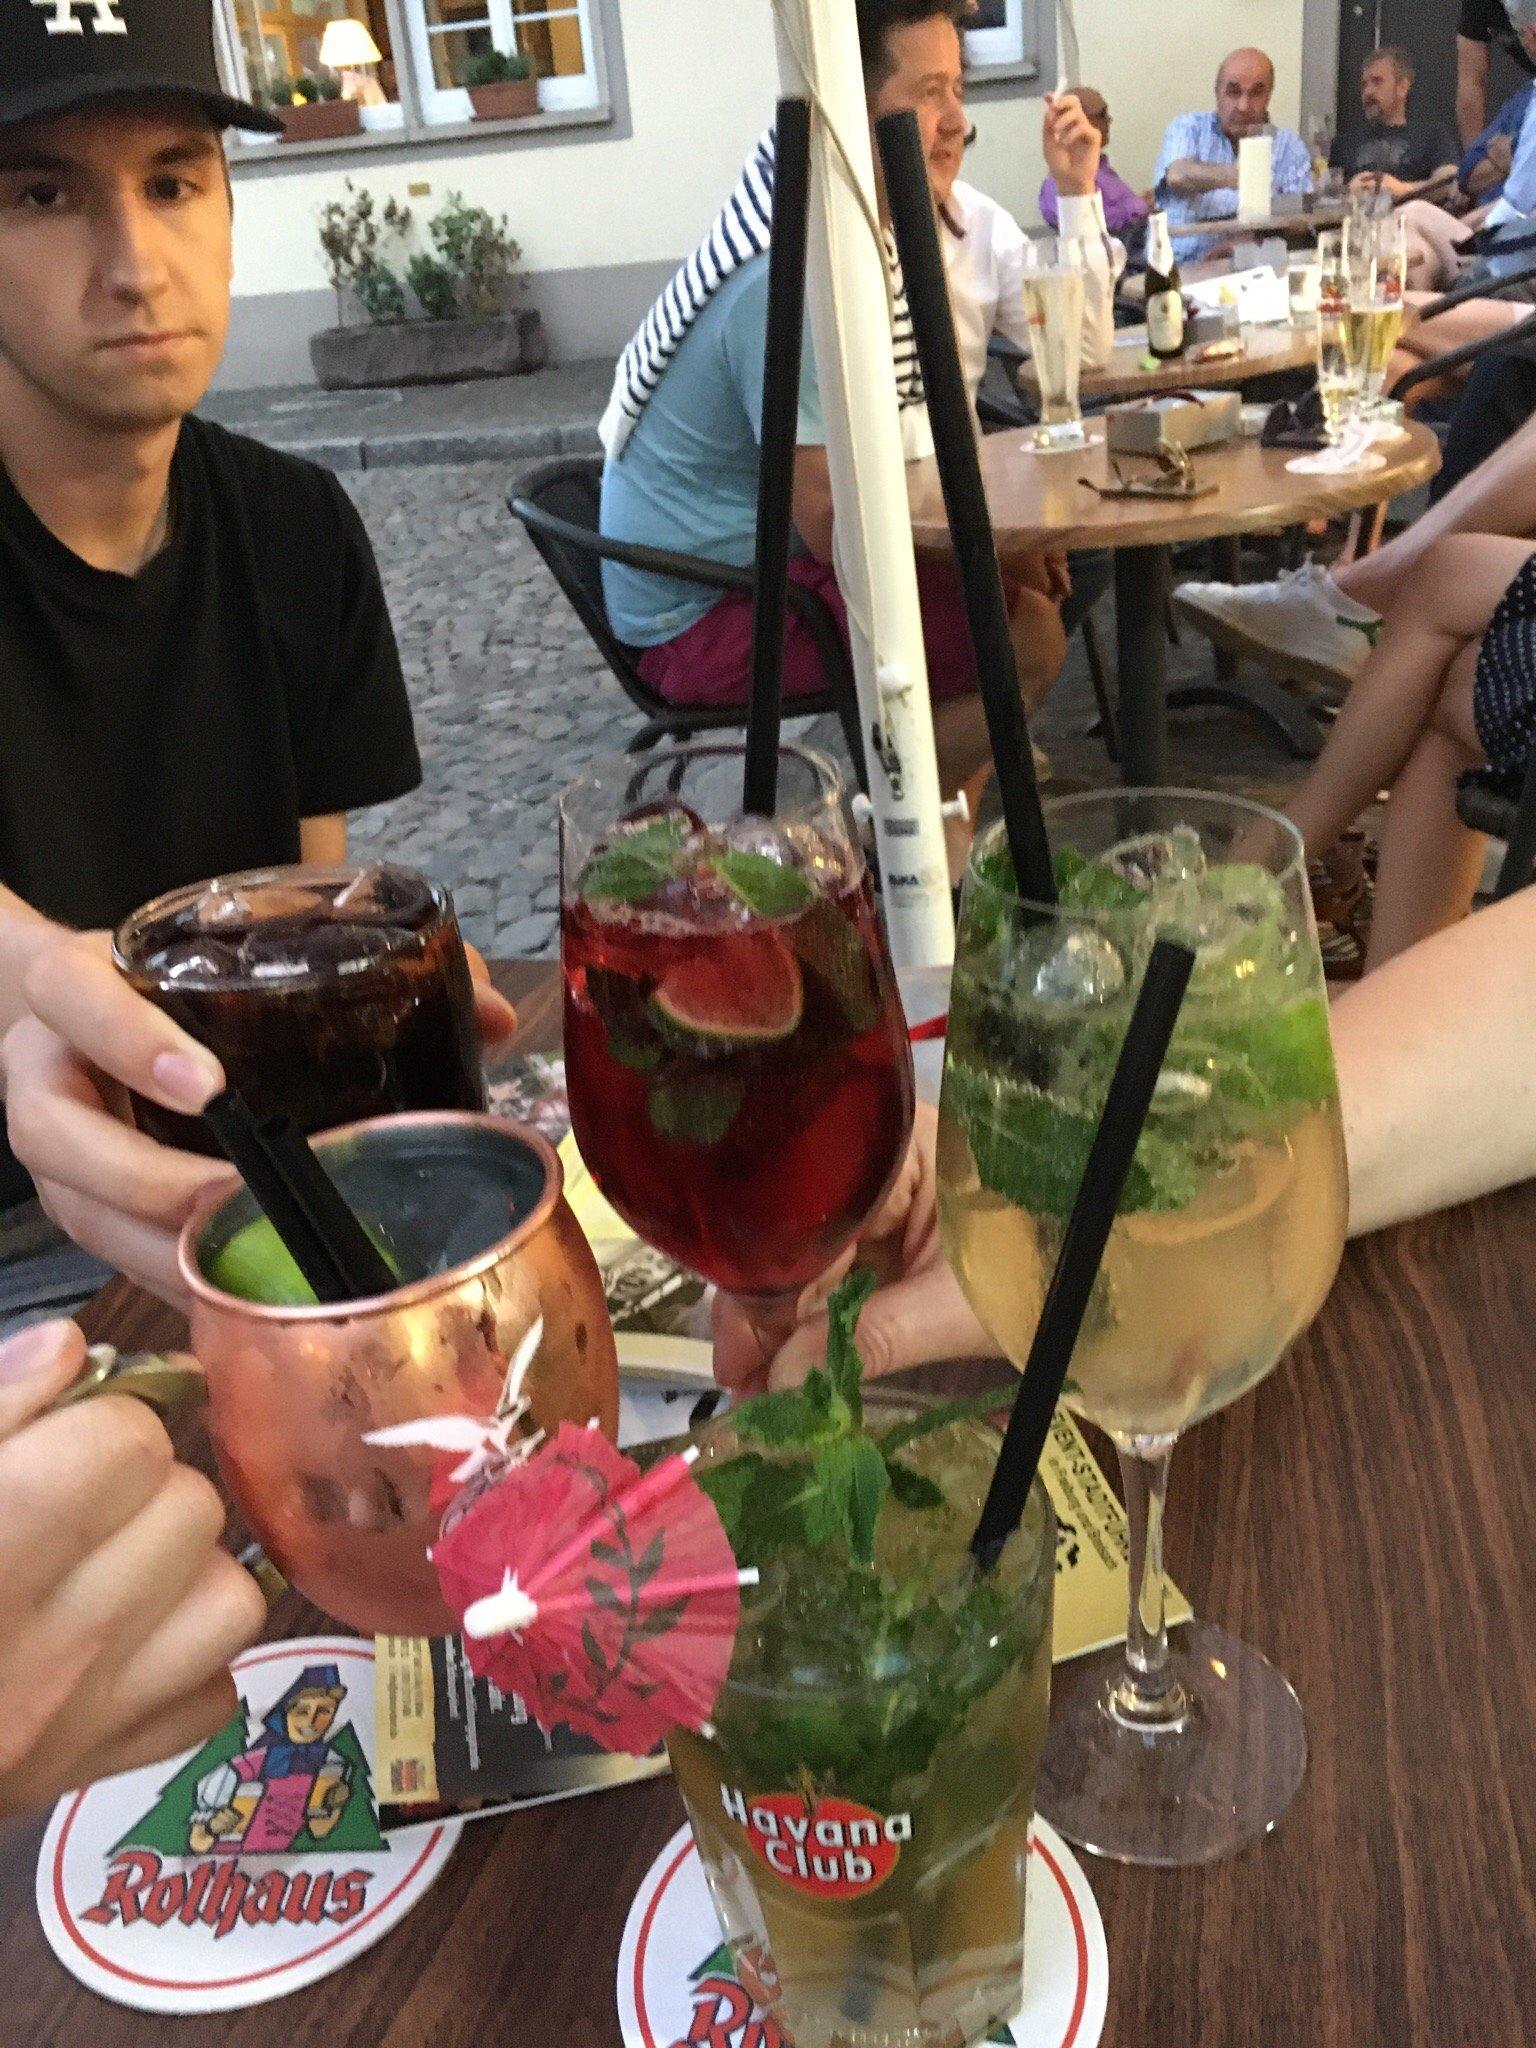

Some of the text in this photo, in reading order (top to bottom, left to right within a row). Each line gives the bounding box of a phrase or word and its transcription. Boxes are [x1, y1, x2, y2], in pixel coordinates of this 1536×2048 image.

[720, 1782, 912, 1847] Havana
[765, 1839, 873, 1883] Club
[78, 1849, 375, 1940] Rothaus
